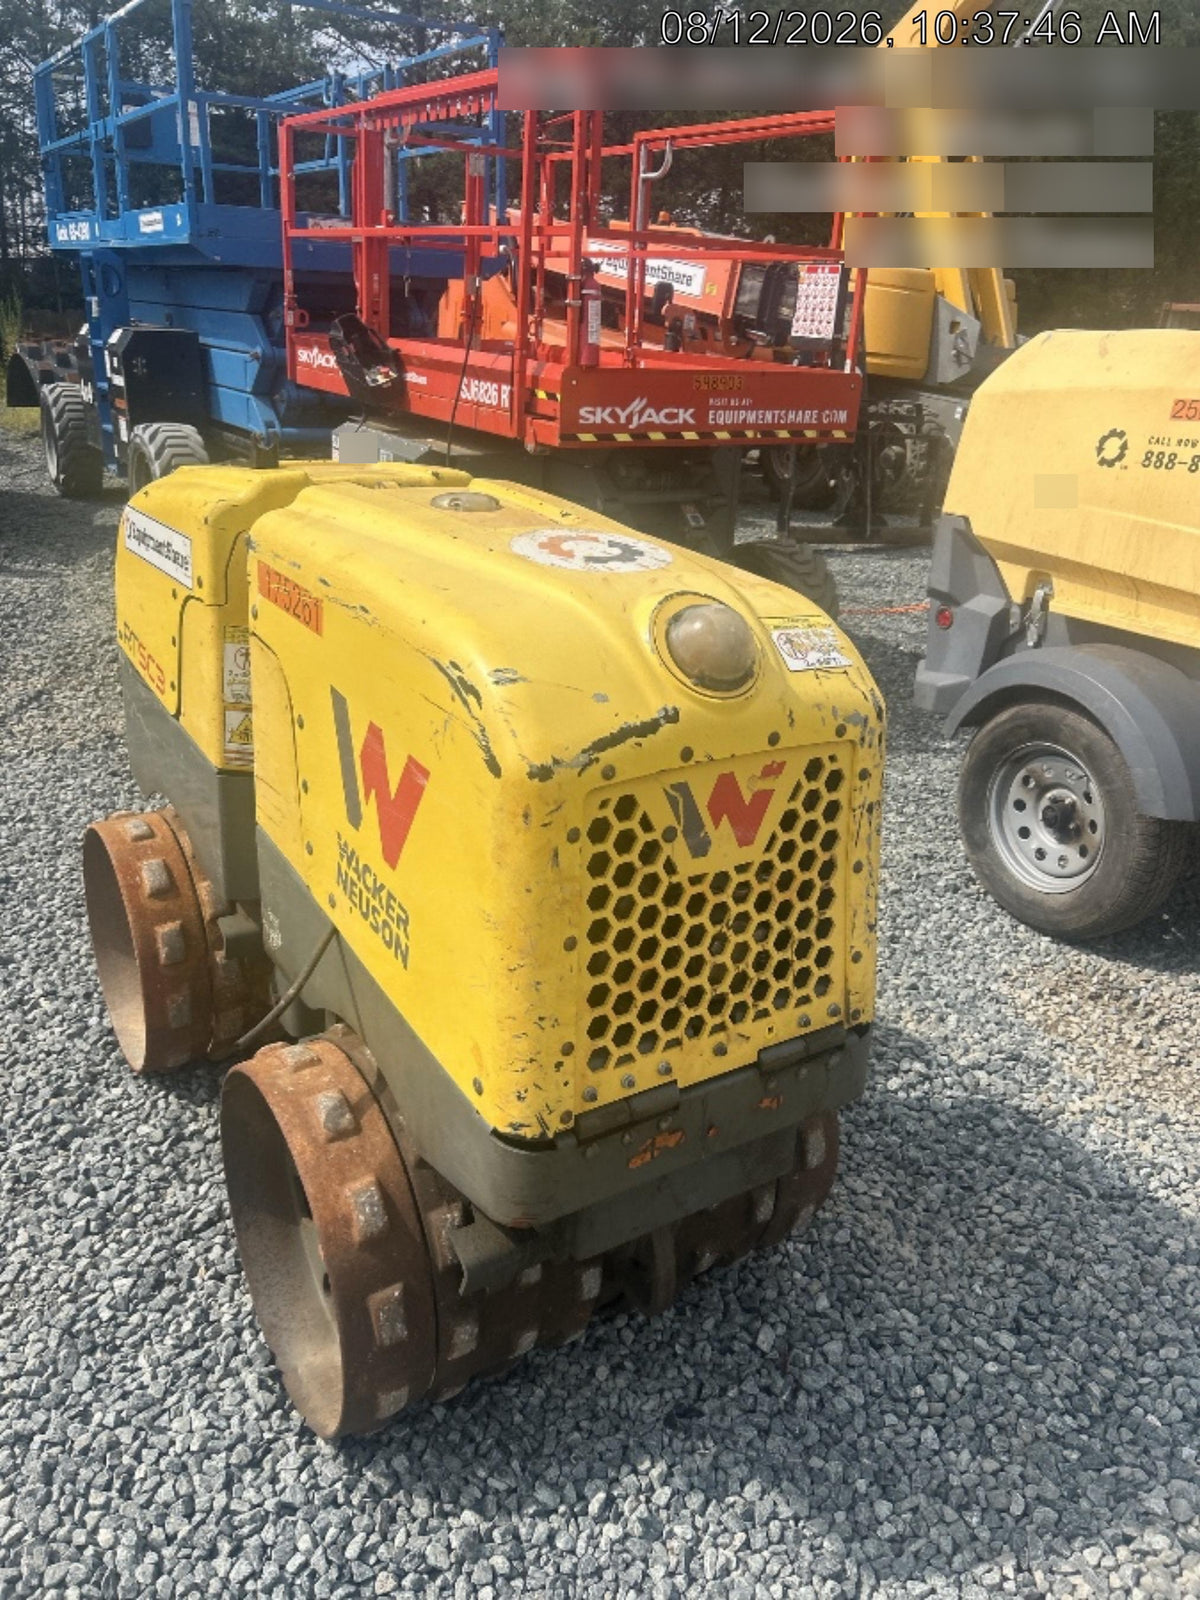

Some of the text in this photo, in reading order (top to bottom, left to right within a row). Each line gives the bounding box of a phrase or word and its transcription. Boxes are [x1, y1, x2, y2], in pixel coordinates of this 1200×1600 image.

[297, 346, 338, 368] SKYJACK
[460, 376, 499, 406] SJ6826
[501, 384, 512, 408] R
[578, 397, 696, 429] SKYJACK
[1148, 435, 1171, 447] CALL
[336, 830, 410, 941] WACKER
[336, 862, 409, 971] NEUSON
